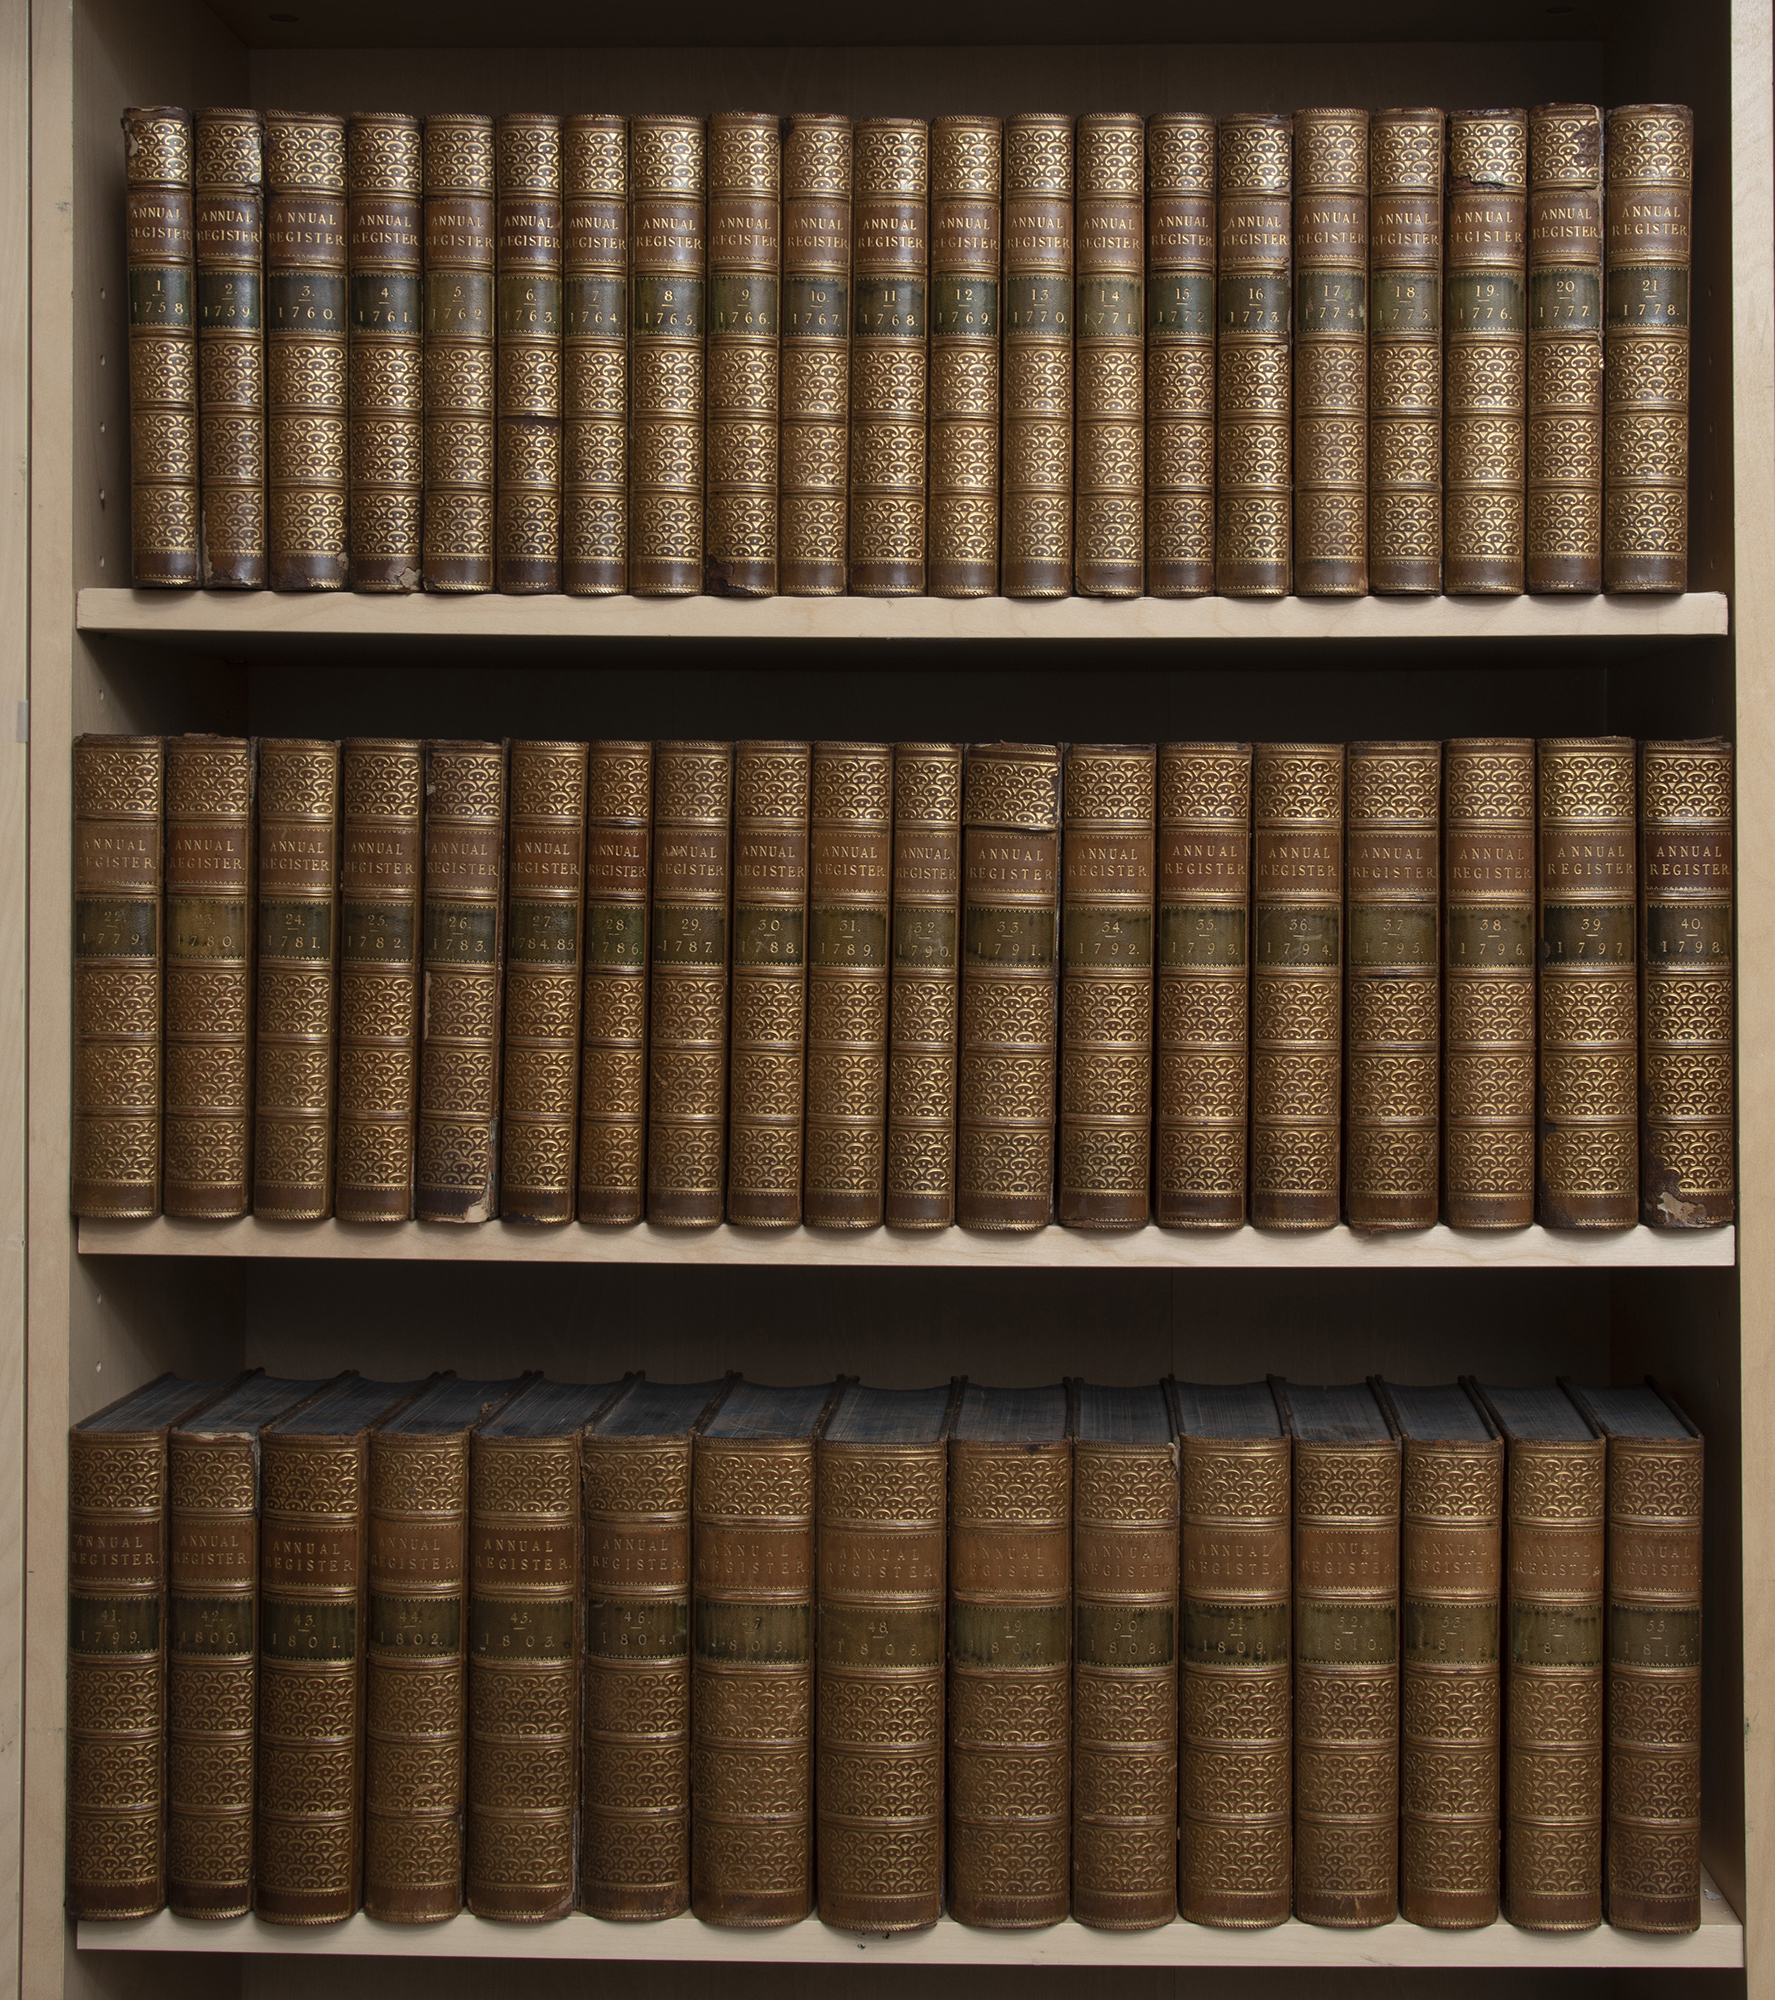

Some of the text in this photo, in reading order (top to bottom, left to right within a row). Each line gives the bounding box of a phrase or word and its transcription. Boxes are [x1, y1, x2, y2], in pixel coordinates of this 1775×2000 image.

[132, 208, 182, 219] ANNUAL
[201, 211, 253, 223] ANNUAL
[1303, 212, 1359, 224] ANNUAL
[1455, 211, 1513, 224] ANNUAL
[1541, 208, 1592, 220] ANNUAL
[1622, 206, 1680, 218] ANNUAL
[276, 212, 336, 226] ANNUAL
[359, 215, 411, 227] ANNUAL
[431, 215, 484, 227] ANNUAL
[504, 216, 554, 228] ANNUAL
[643, 218, 696, 230] ANNUAL
[718, 218, 771, 230] ANNUAL
[791, 218, 843, 230] ANNUAL
[863, 218, 916, 230] ANNUAL
[1011, 217, 1063, 229] ANNUAL
[1083, 217, 1134, 229] ANNUAL
[1157, 215, 1208, 227] ANNUAL
[1229, 216, 1281, 228] ANNUAL
[1377, 212, 1431, 226] ANNUAL
[83, 839, 147, 851] ANNUAL
[175, 839, 234, 852] ANNUAL
[270, 841, 324, 854] ANNUAL
[351, 843, 404, 856] ANNUAL
[431, 843, 488, 856] ANNUAL
[515, 842, 570, 856] ANNUAL
[592, 844, 640, 858] ANNUAL
[742, 845, 795, 858] ANNUAL
[822, 845, 878, 859] ANNUAL
[901, 847, 950, 860] ANNUAL
[979, 849, 1043, 861] ANNUAL
[1078, 848, 1138, 860] ANNUAL
[1172, 845, 1237, 858] ANNUAL
[1269, 847, 1331, 859] ANNUAL
[1361, 848, 1423, 860] ANNUAL
[1460, 848, 1524, 860] ANNUAL
[1558, 846, 1625, 858] ANNUAL
[1657, 846, 1722, 857] ANNUAL
[75, 1535, 143, 1549] ANNUAL
[180, 1535, 239, 1547] ANNUAL
[484, 1539, 554, 1553] ANNUAL
[603, 1539, 669, 1551] ANNUAL
[273, 1541, 341, 1555] ANNUAL
[1090, 1546, 1164, 1558] ANNUAL
[1199, 1545, 1271, 1557] ANNUAL
[1312, 1543, 1379, 1555] ANNUAL
